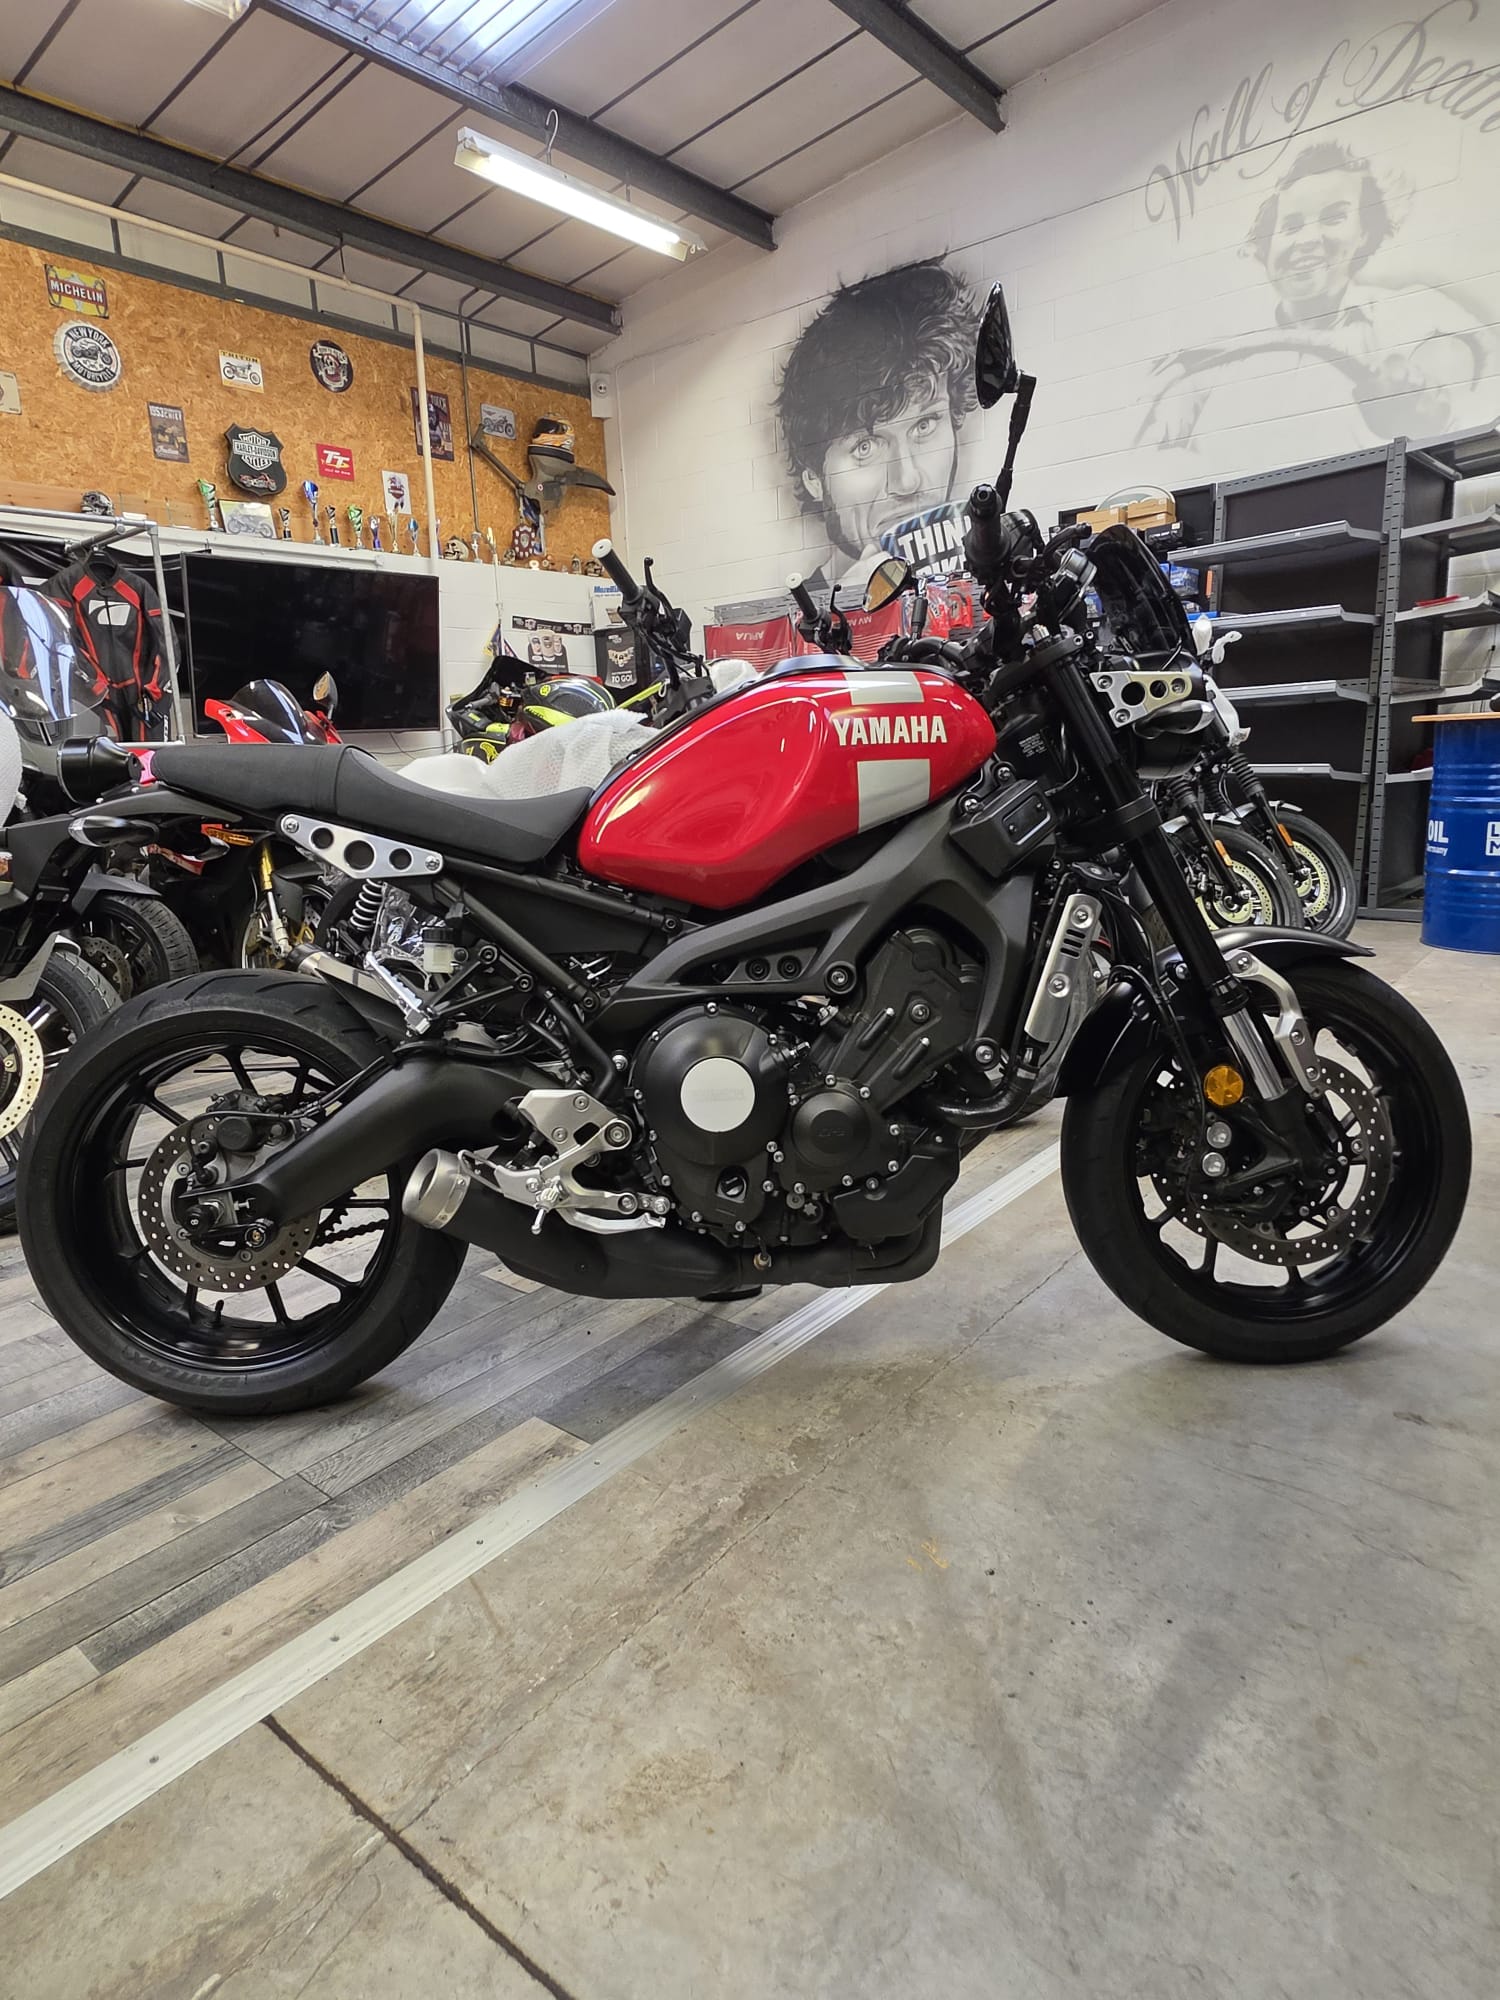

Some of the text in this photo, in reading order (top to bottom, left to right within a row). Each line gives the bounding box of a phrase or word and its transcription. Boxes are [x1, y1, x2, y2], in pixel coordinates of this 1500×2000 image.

[1145, 62, 1272, 243] Wall
[1238, 38, 1350, 180] of
[50, 279, 104, 303] MICHELIN
[323, 449, 350, 468] TT
[611, 675, 620, 684] TO
[833, 715, 948, 746] YAMAHA
[1427, 820, 1449, 843] OIL
